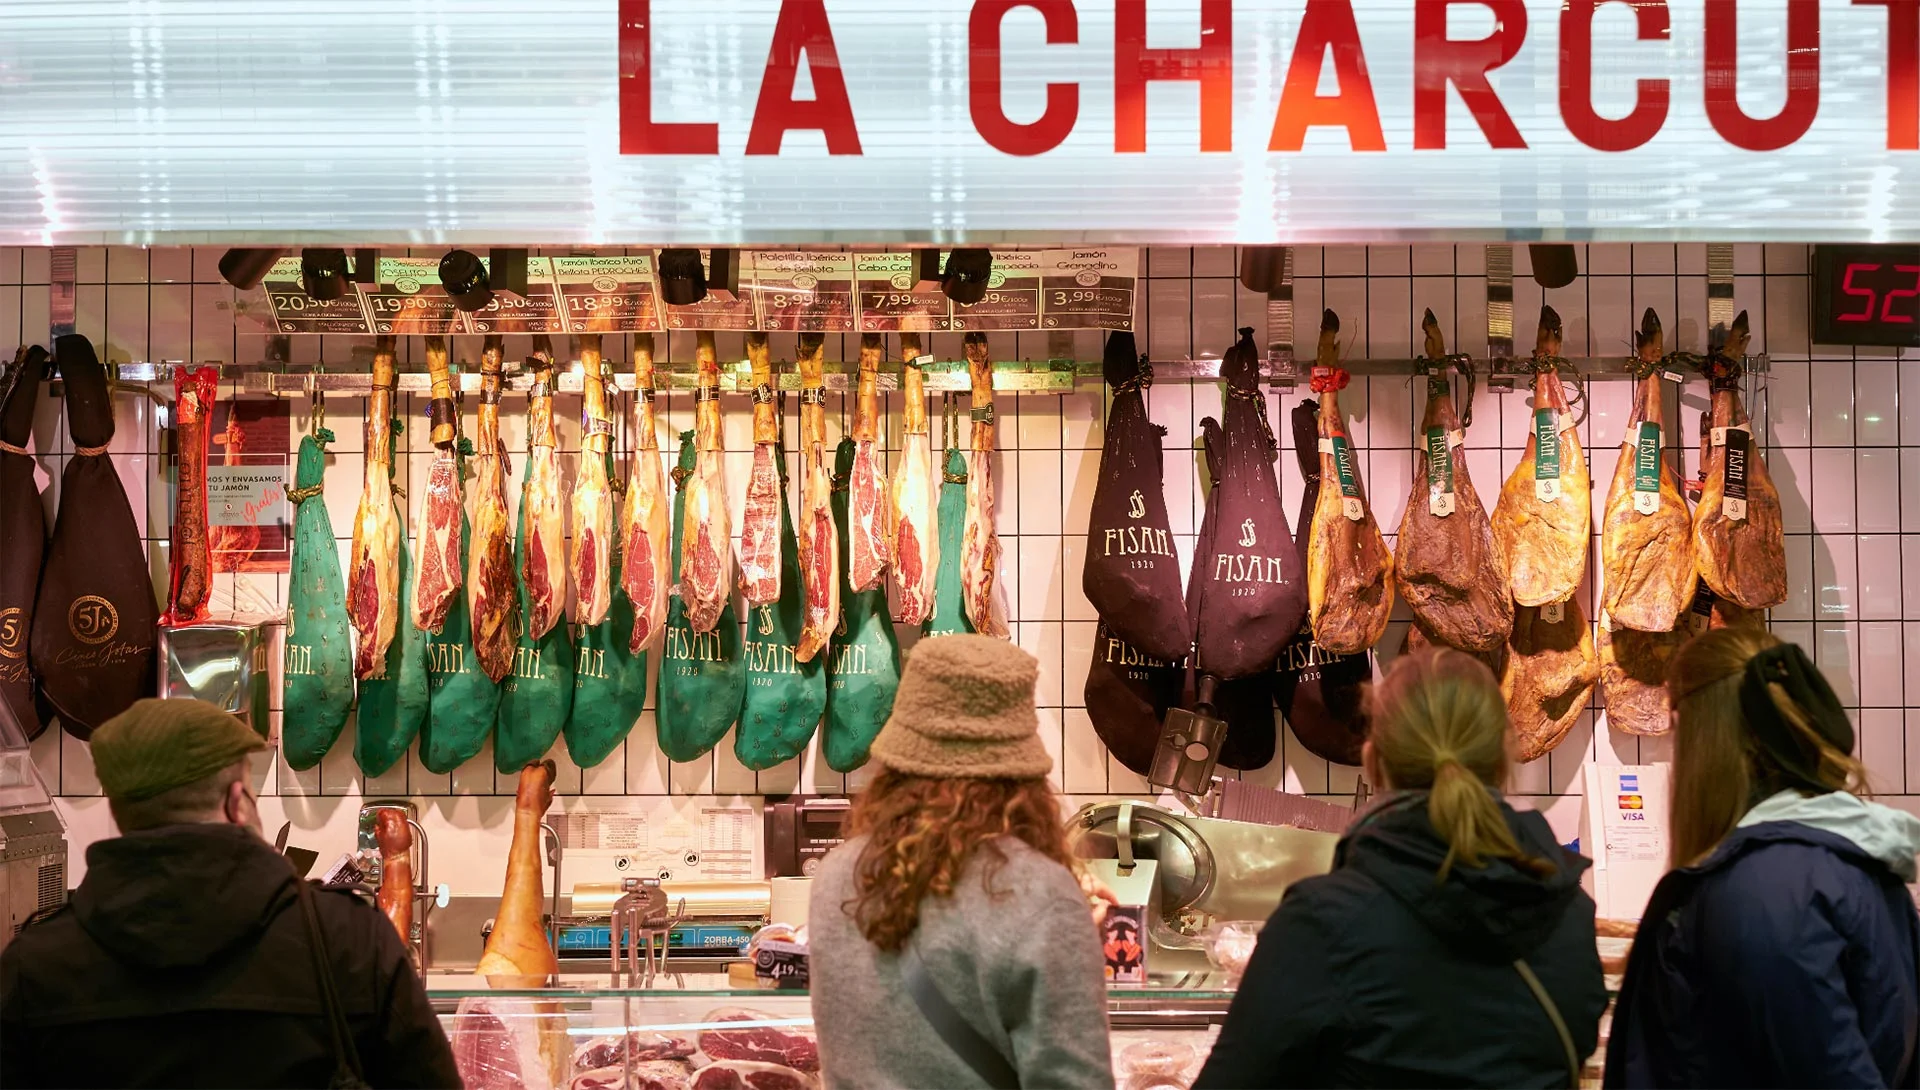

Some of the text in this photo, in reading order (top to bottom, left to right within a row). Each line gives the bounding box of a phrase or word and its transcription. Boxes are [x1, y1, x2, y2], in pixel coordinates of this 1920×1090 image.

[619, 0, 1920, 156] LA CHARCUT
[1071, 251, 1107, 260] Jamón
[1056, 261, 1118, 271] Granadino
[1836, 263, 1920, 323] 52
[232, 475, 283, 483] ENVASAMOS
[220, 483, 250, 491] JAMÓN
[1104, 526, 1171, 557] FISAN
[1130, 560, 1154, 569] 1920
[1213, 554, 1284, 584] FISAN
[1232, 588, 1256, 597] 1920
[1621, 812, 1645, 821] VISA
[704, 935, 750, 944] ZORBA-450
